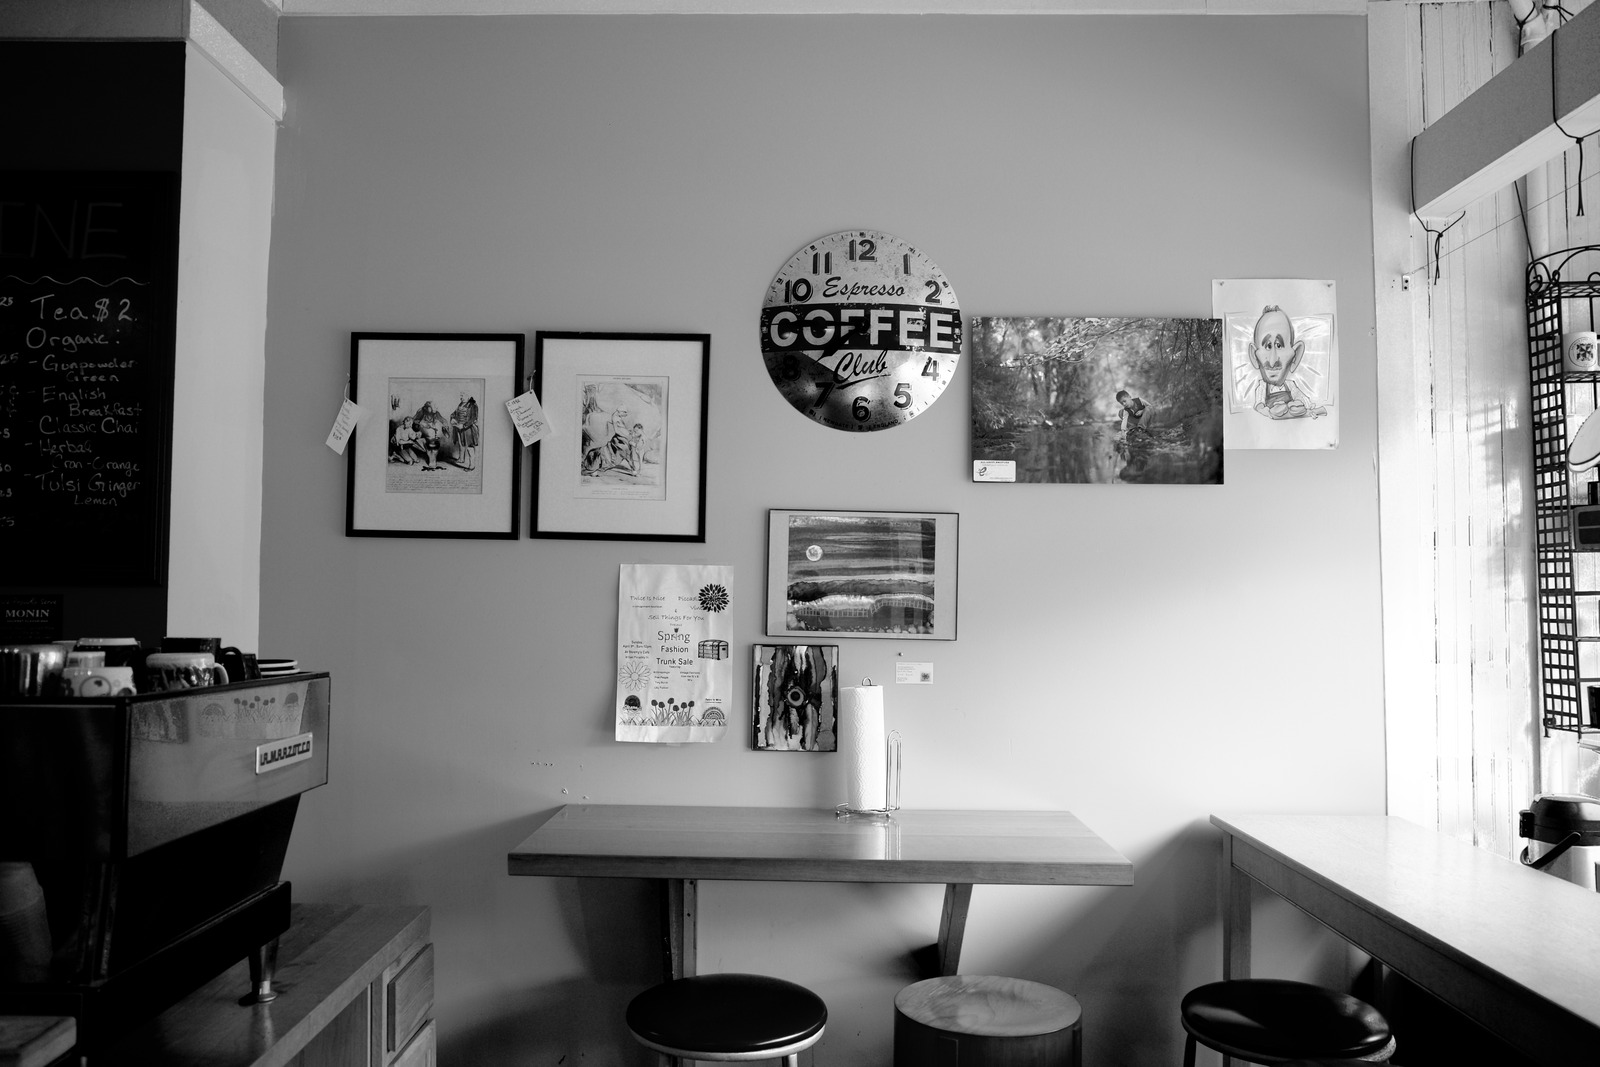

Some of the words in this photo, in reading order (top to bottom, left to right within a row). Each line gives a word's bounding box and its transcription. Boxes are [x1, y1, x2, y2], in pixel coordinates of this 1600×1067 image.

[849, 239, 877, 262] 12
[812, 252, 832, 275] 11
[903, 253, 912, 275] 1
[784, 278, 813, 304] 10
[822, 276, 905, 300] Espresso
[925, 280, 942, 304] 2
[770, 309, 953, 348] COFFEE
[66, 371, 119, 382] Green
[782, 354, 800, 382] 8
[833, 349, 888, 384] Club
[921, 356, 940, 381] 4
[42, 385, 107, 408] English
[814, 381, 836, 410] 7
[893, 382, 914, 410] 5
[69, 402, 143, 417] Breakfast
[852, 396, 871, 422] 6
[39, 415, 97, 435] Classic
[101, 416, 139, 435] Chai
[35, 470, 81, 492] Tulsi
[88, 473, 141, 498] Ginger
[74, 494, 118, 506] Lemon
[5, 609, 50, 618] MONIN
[657, 630, 691, 643] Spring
[660, 645, 689, 653] Fashion
[656, 657, 677, 666] Trunk
[678, 658, 694, 666] Sale
